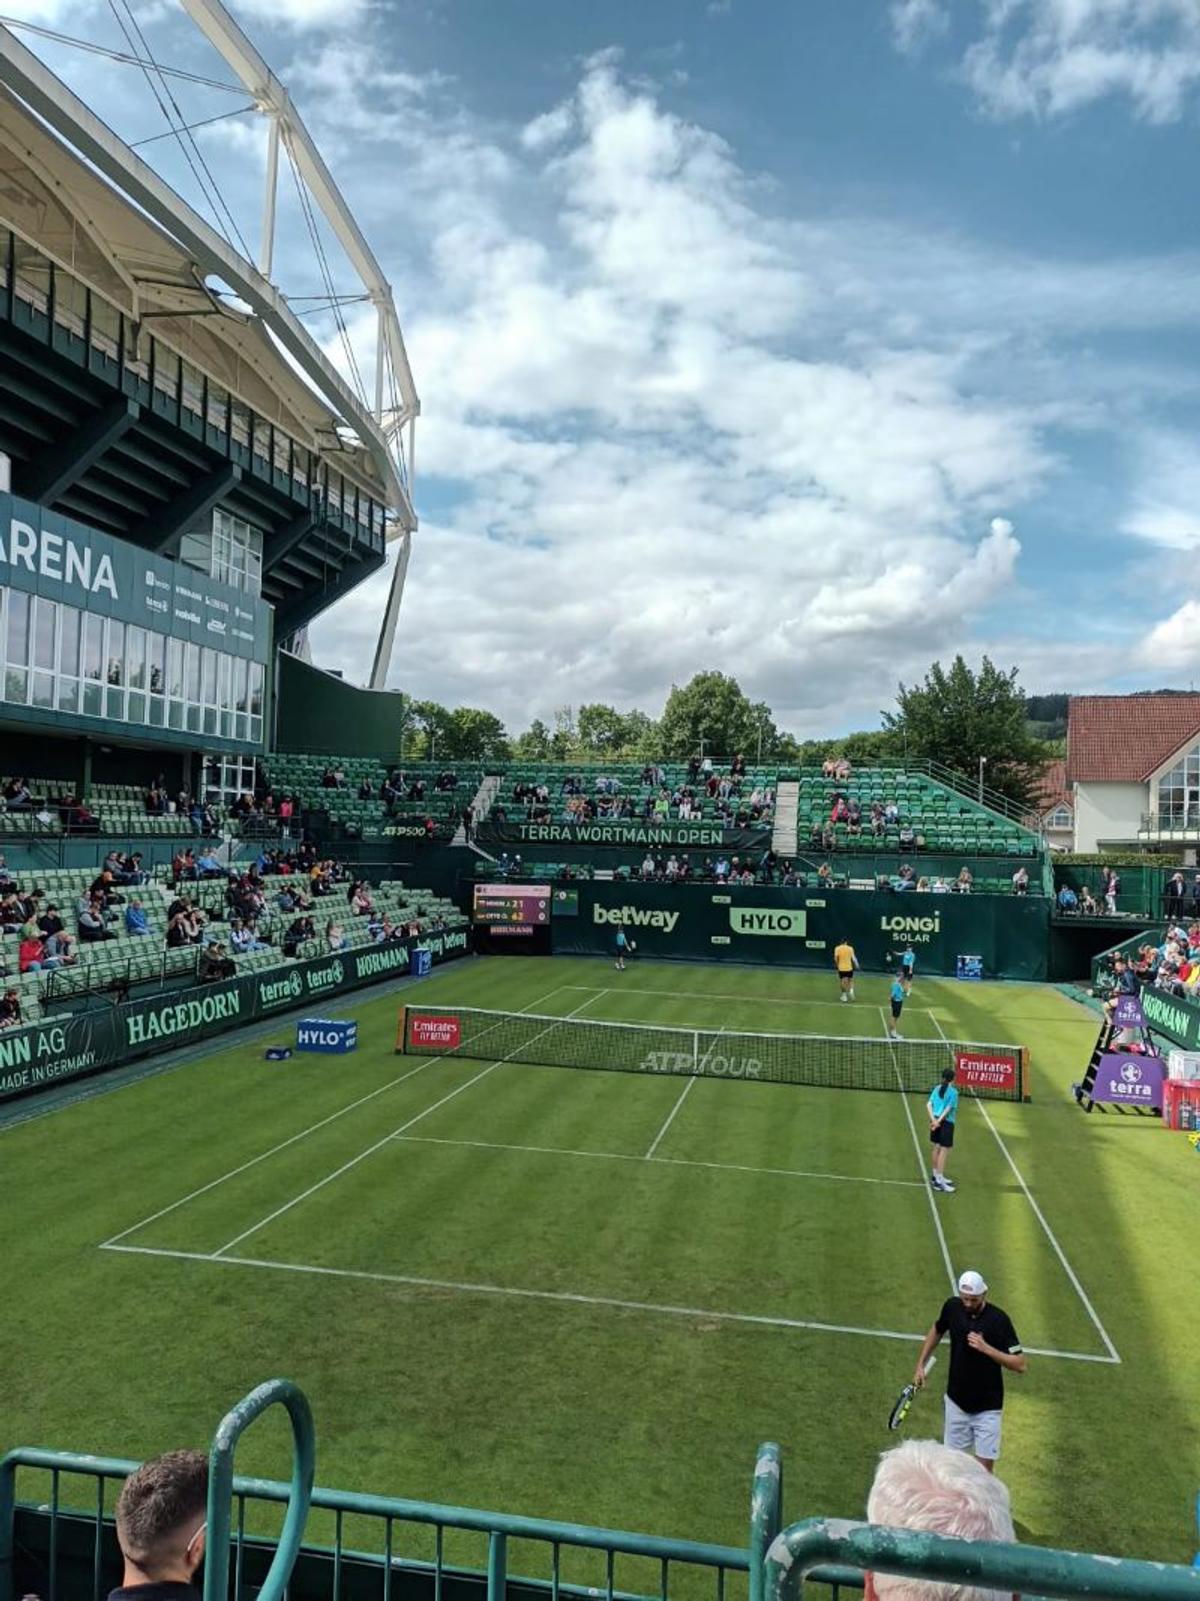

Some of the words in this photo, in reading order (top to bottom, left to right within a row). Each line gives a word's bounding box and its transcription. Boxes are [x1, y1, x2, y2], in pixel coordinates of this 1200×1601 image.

[519, 825, 571, 841] TERRA
[576, 827, 673, 843] WORTMANN
[678, 829, 722, 844] OPEN
[594, 903, 680, 932] betway
[892, 932, 931, 942] SOLAR
[260, 980, 291, 1003] terra
[306, 968, 333, 988] terra
[127, 990, 240, 1045] HAGEDORN
[413, 1020, 458, 1032] Emirates
[37, 1028, 66, 1057] AG
[298, 1030, 339, 1045] HYLO
[640, 1051, 694, 1072] ATP
[960, 1058, 1012, 1074] Emirates
[31, 1066, 46, 1081] IN
[1110, 1079, 1152, 1096] terra
